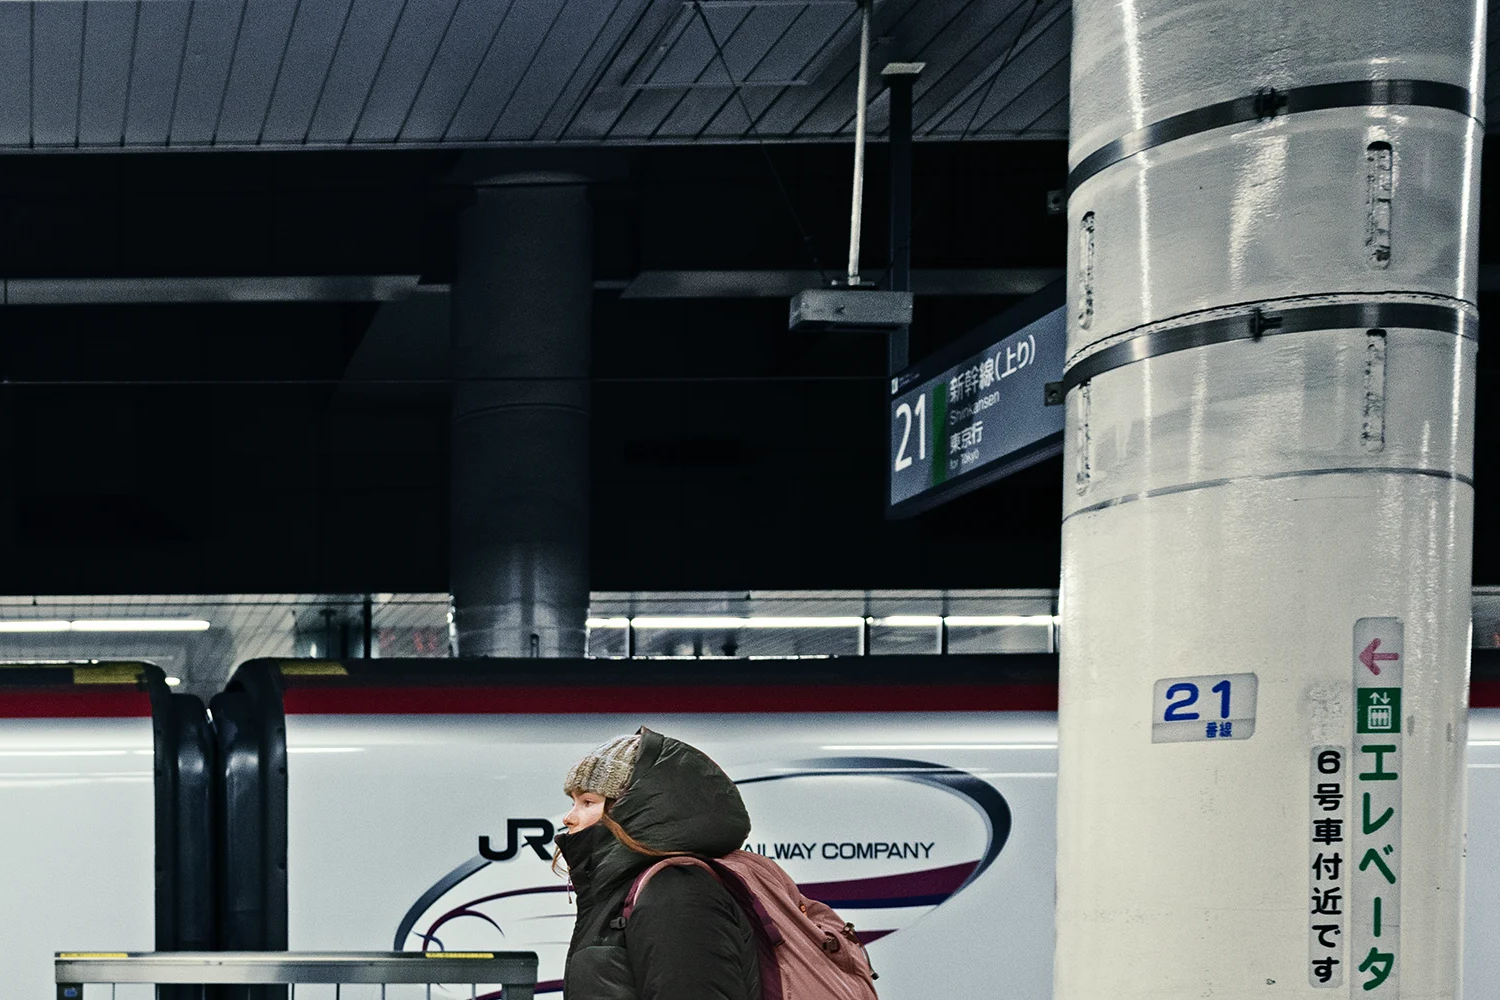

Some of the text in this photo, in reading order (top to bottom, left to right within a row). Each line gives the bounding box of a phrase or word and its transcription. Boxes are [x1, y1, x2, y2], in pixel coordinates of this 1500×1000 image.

[895, 393, 926, 472] 21
[949, 420, 983, 455] 東京行
[1163, 680, 1231, 722] 21
[1205, 721, 1233, 739] 番線
[478, 818, 554, 861] JR
[743, 842, 935, 860] AILWAY COMPANY
[1311, 750, 1344, 984] 6号車付近です
